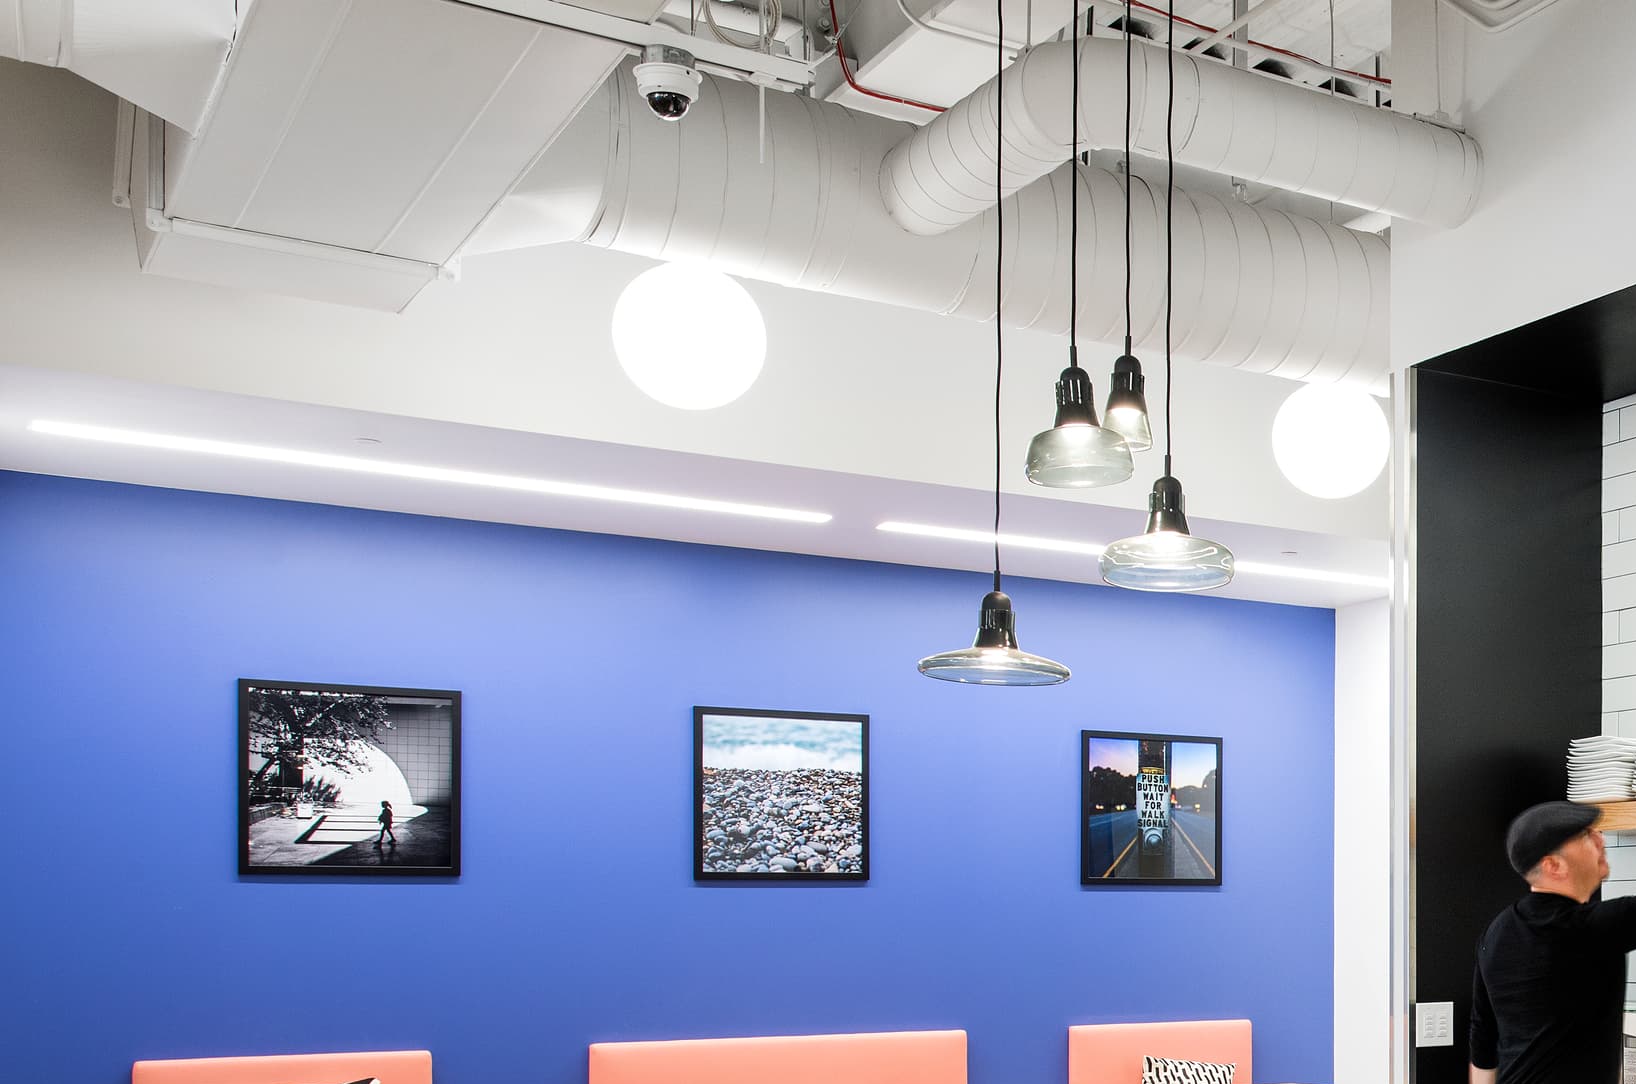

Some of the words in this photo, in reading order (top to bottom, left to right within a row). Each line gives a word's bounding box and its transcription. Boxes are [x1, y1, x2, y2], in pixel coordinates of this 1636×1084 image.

[1142, 775, 1165, 783] PUSH
[1138, 783, 1168, 792] BUTTON
[1143, 793, 1164, 801] WAIT
[1145, 802, 1162, 810] FOR
[1142, 811, 1165, 819] WALK
[1138, 819, 1168, 828] SIGNAL
